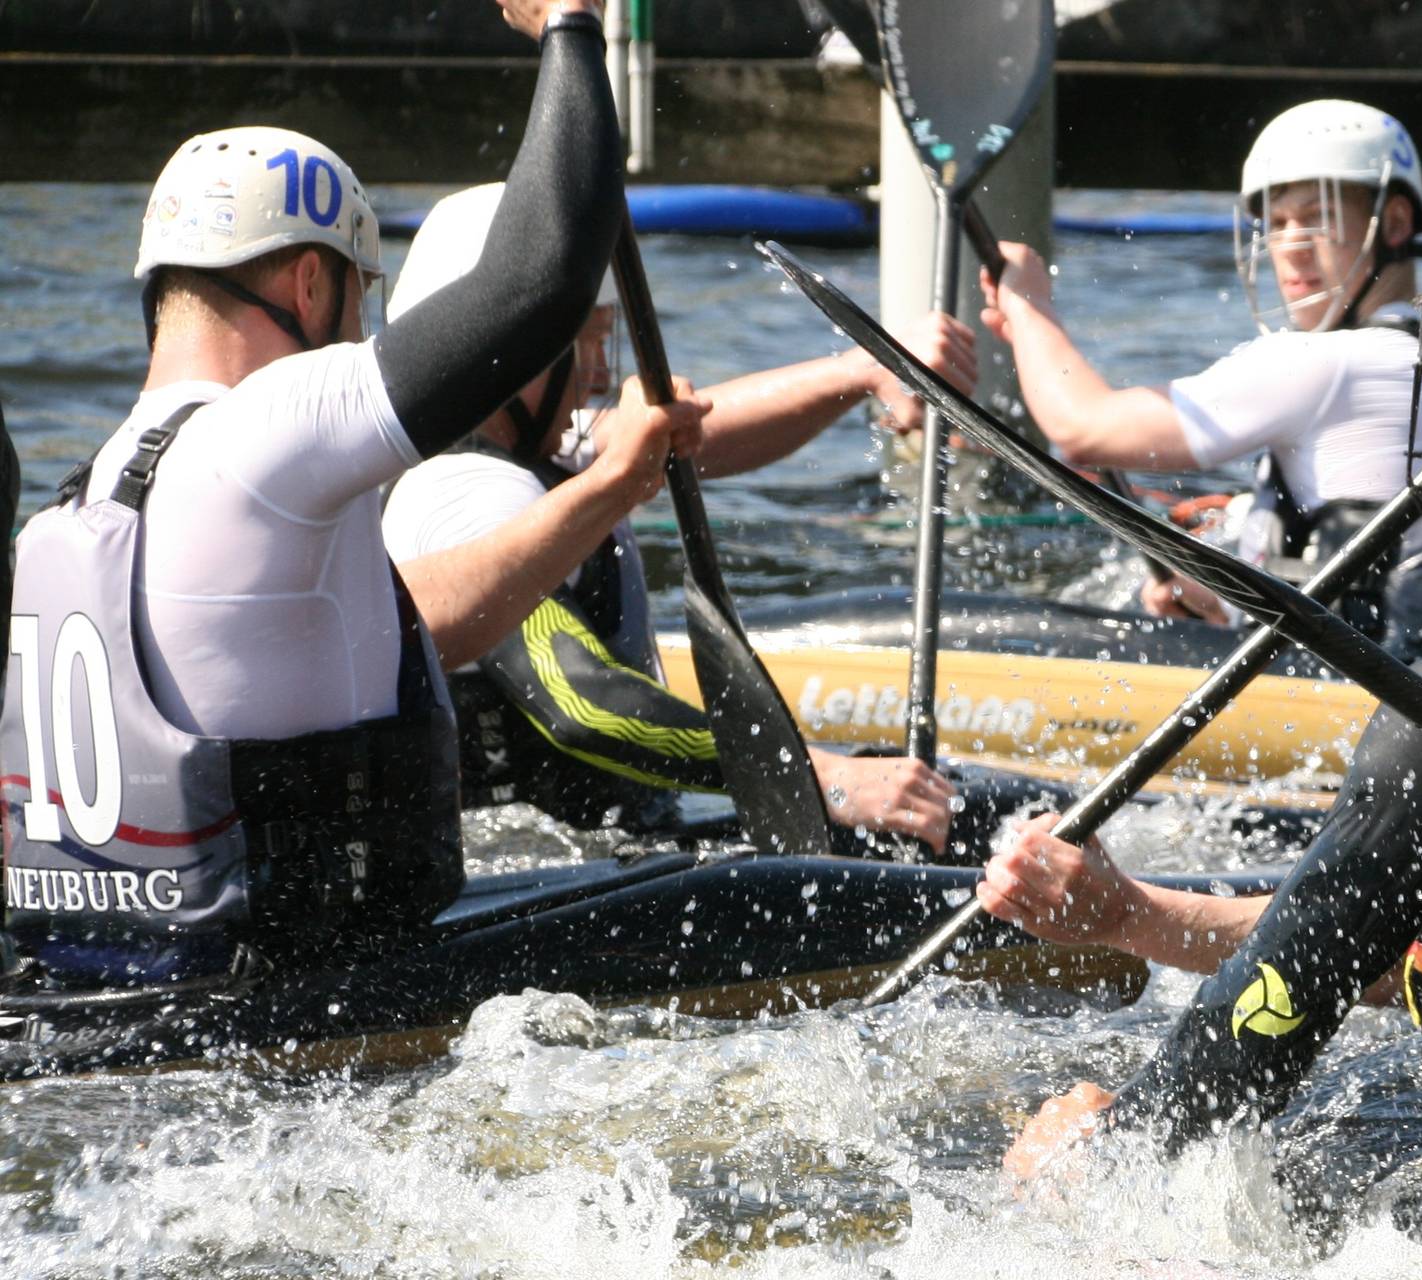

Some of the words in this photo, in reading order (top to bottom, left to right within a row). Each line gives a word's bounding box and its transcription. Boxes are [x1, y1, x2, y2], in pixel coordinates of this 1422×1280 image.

[266, 148, 343, 227] 10
[9, 612, 123, 847] 10
[799, 676, 1036, 735] Lettann
[7, 868, 184, 911] NEUBURG
